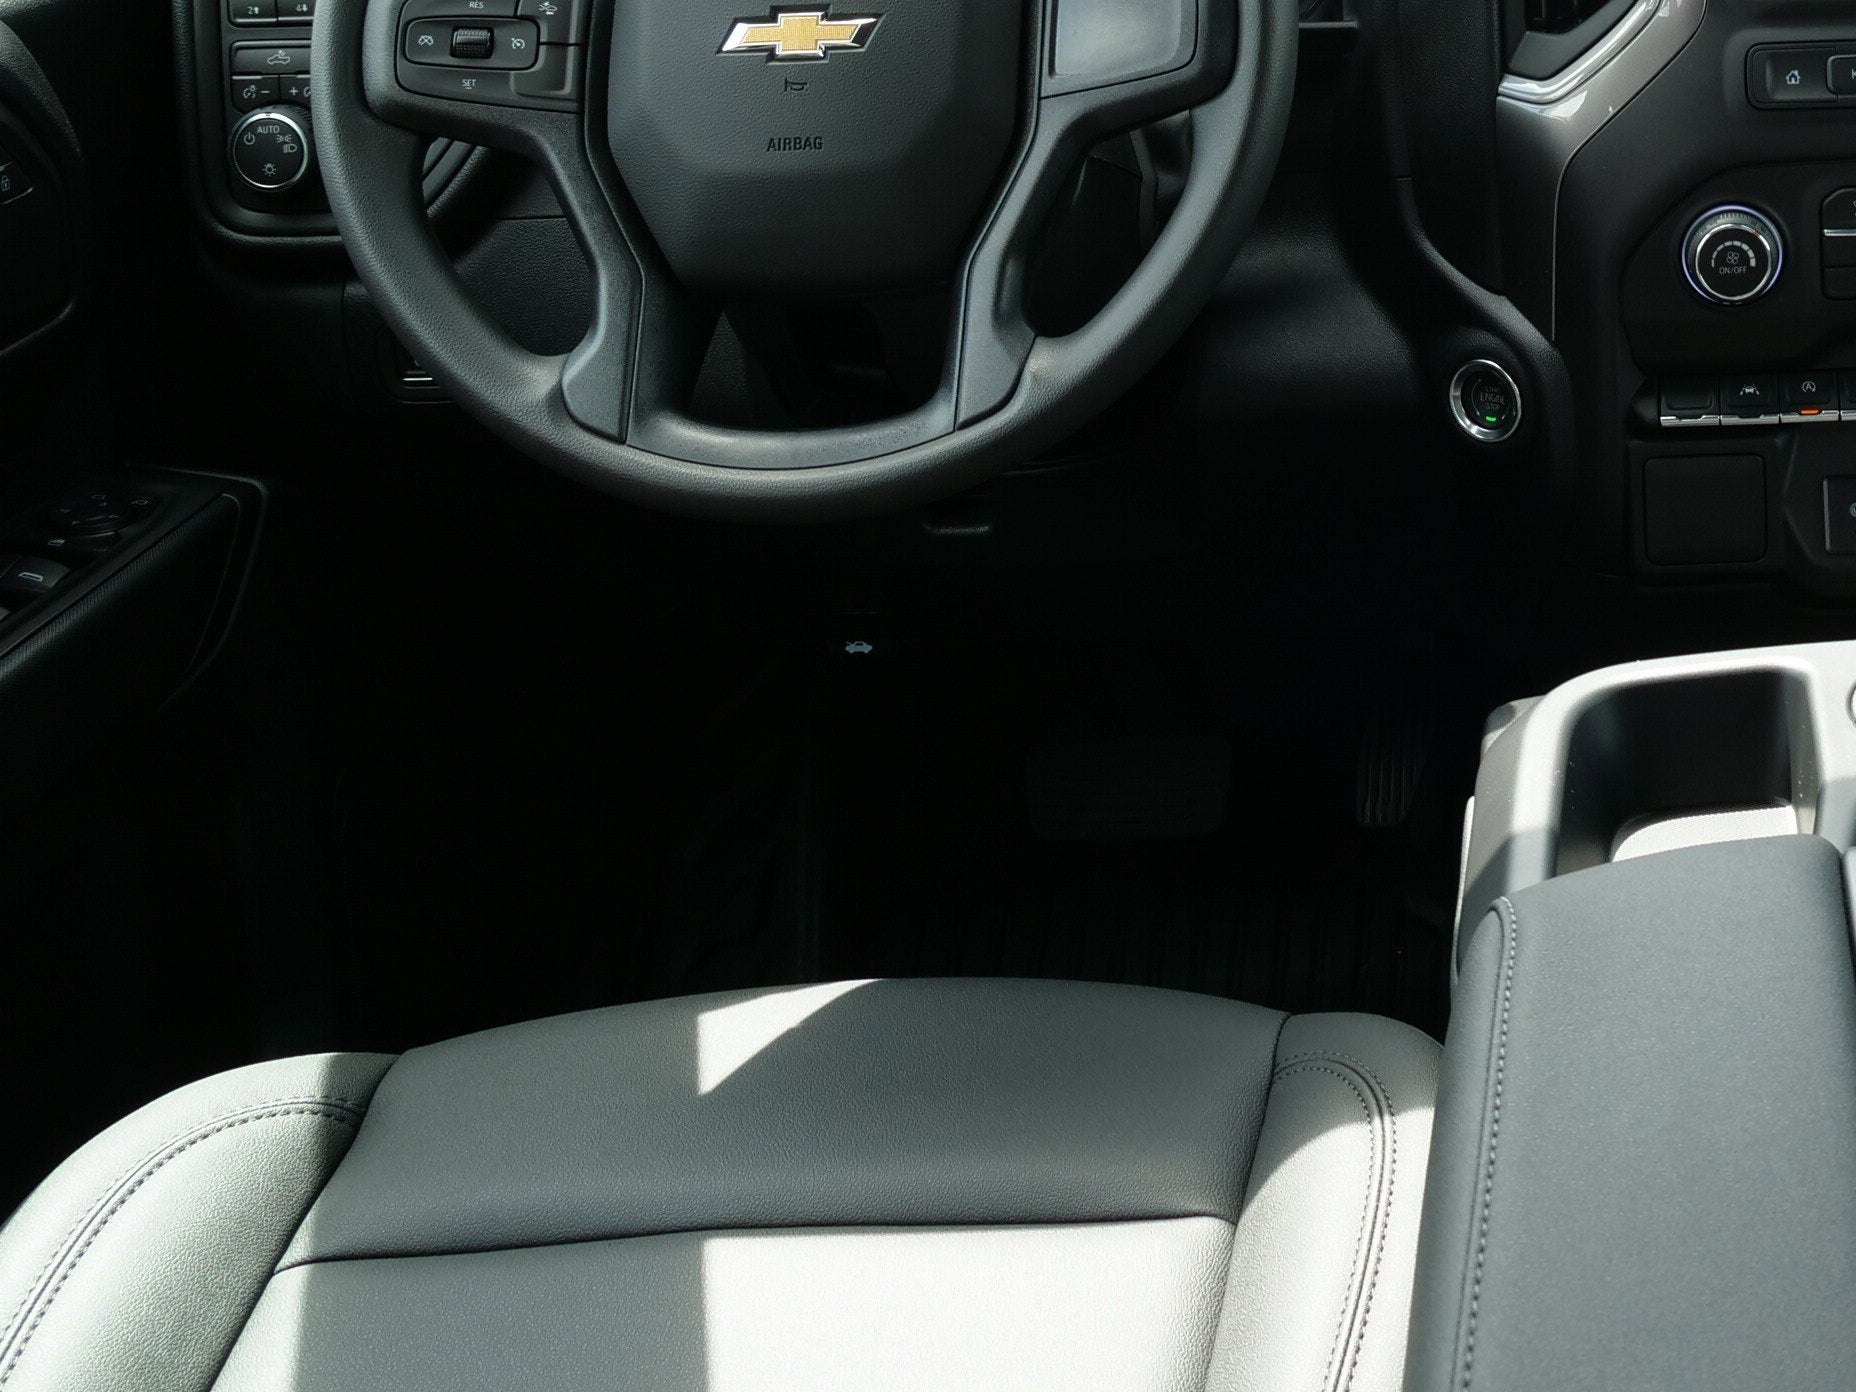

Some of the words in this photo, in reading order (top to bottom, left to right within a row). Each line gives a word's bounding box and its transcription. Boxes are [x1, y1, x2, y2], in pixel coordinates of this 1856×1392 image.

[469, 1, 485, 9] RES
[462, 78, 477, 87] SET
[257, 125, 280, 134] AUTO
[766, 136, 823, 152] AIRBAG
[1719, 265, 1748, 275] ON/OFF
